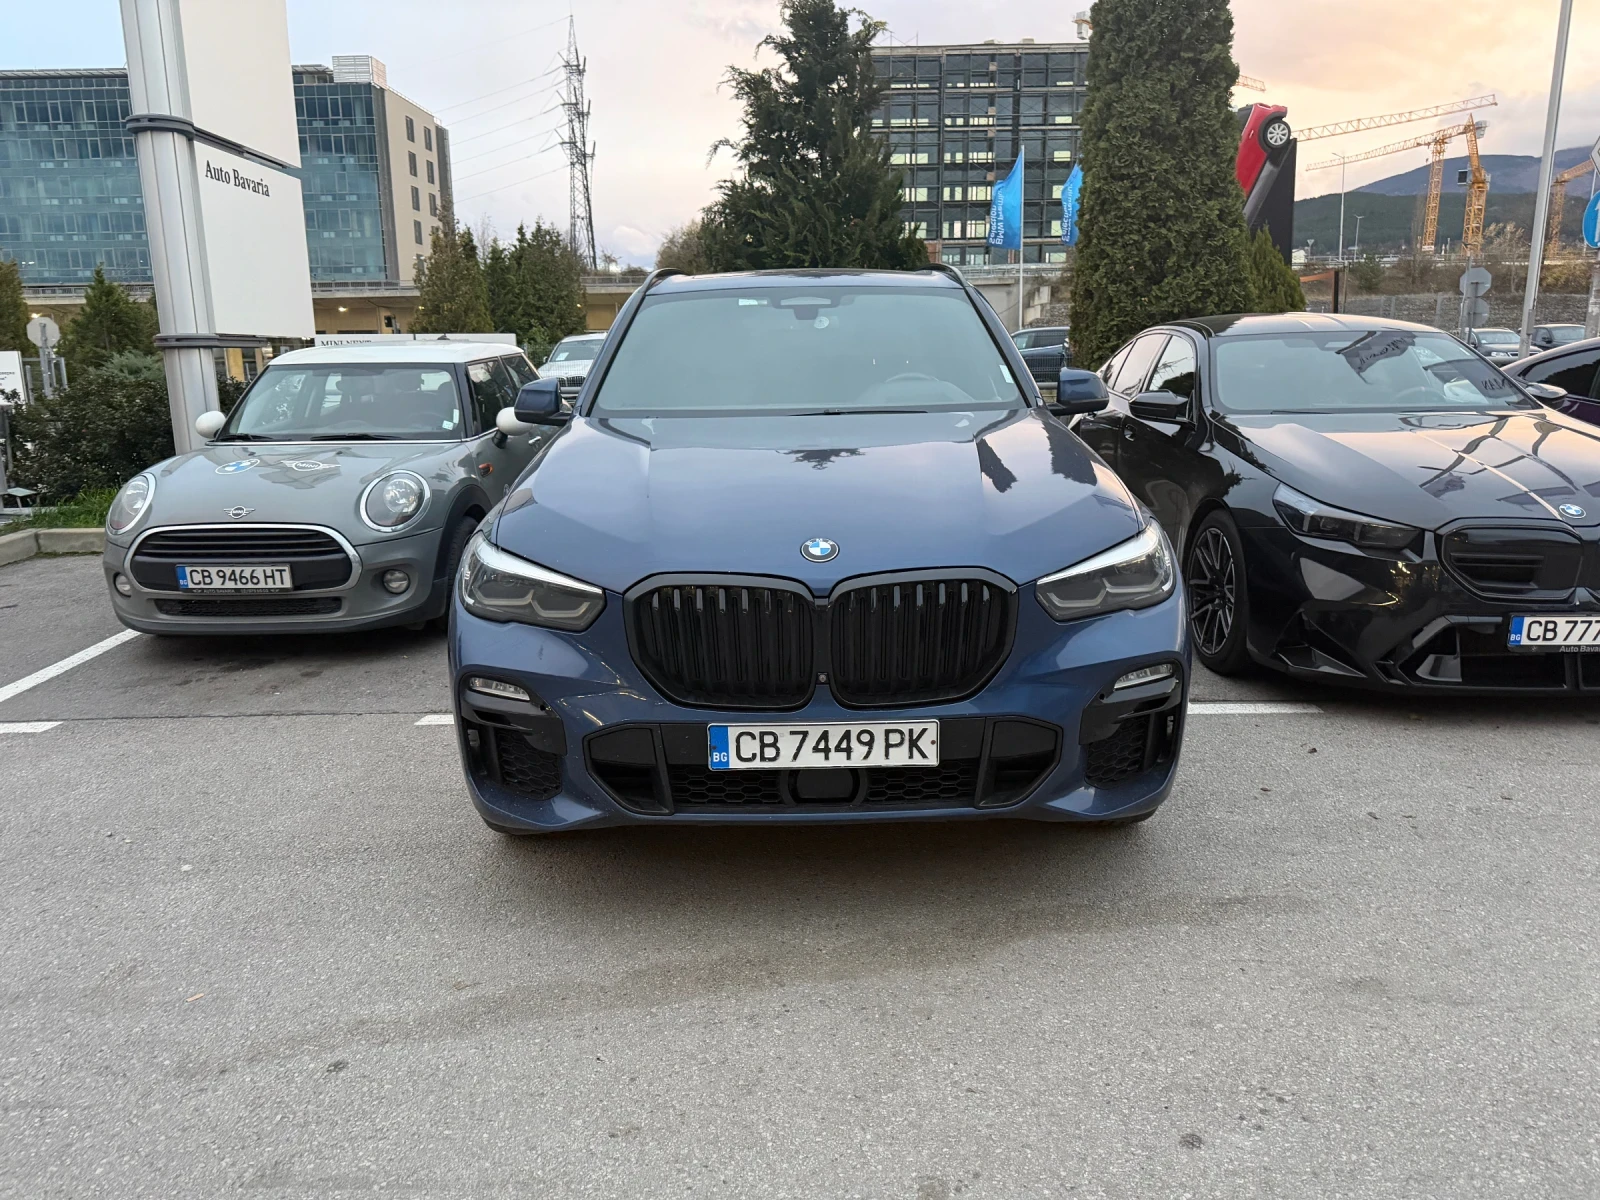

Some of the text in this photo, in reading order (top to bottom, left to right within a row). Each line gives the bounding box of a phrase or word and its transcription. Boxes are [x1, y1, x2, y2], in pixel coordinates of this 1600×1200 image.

[205, 160, 270, 197] Auto Bavaria
[189, 569, 287, 586] CB 9466 HT
[1526, 620, 1558, 642] CB
[735, 728, 929, 762] CB 7449 PK
[713, 752, 728, 762] BG
